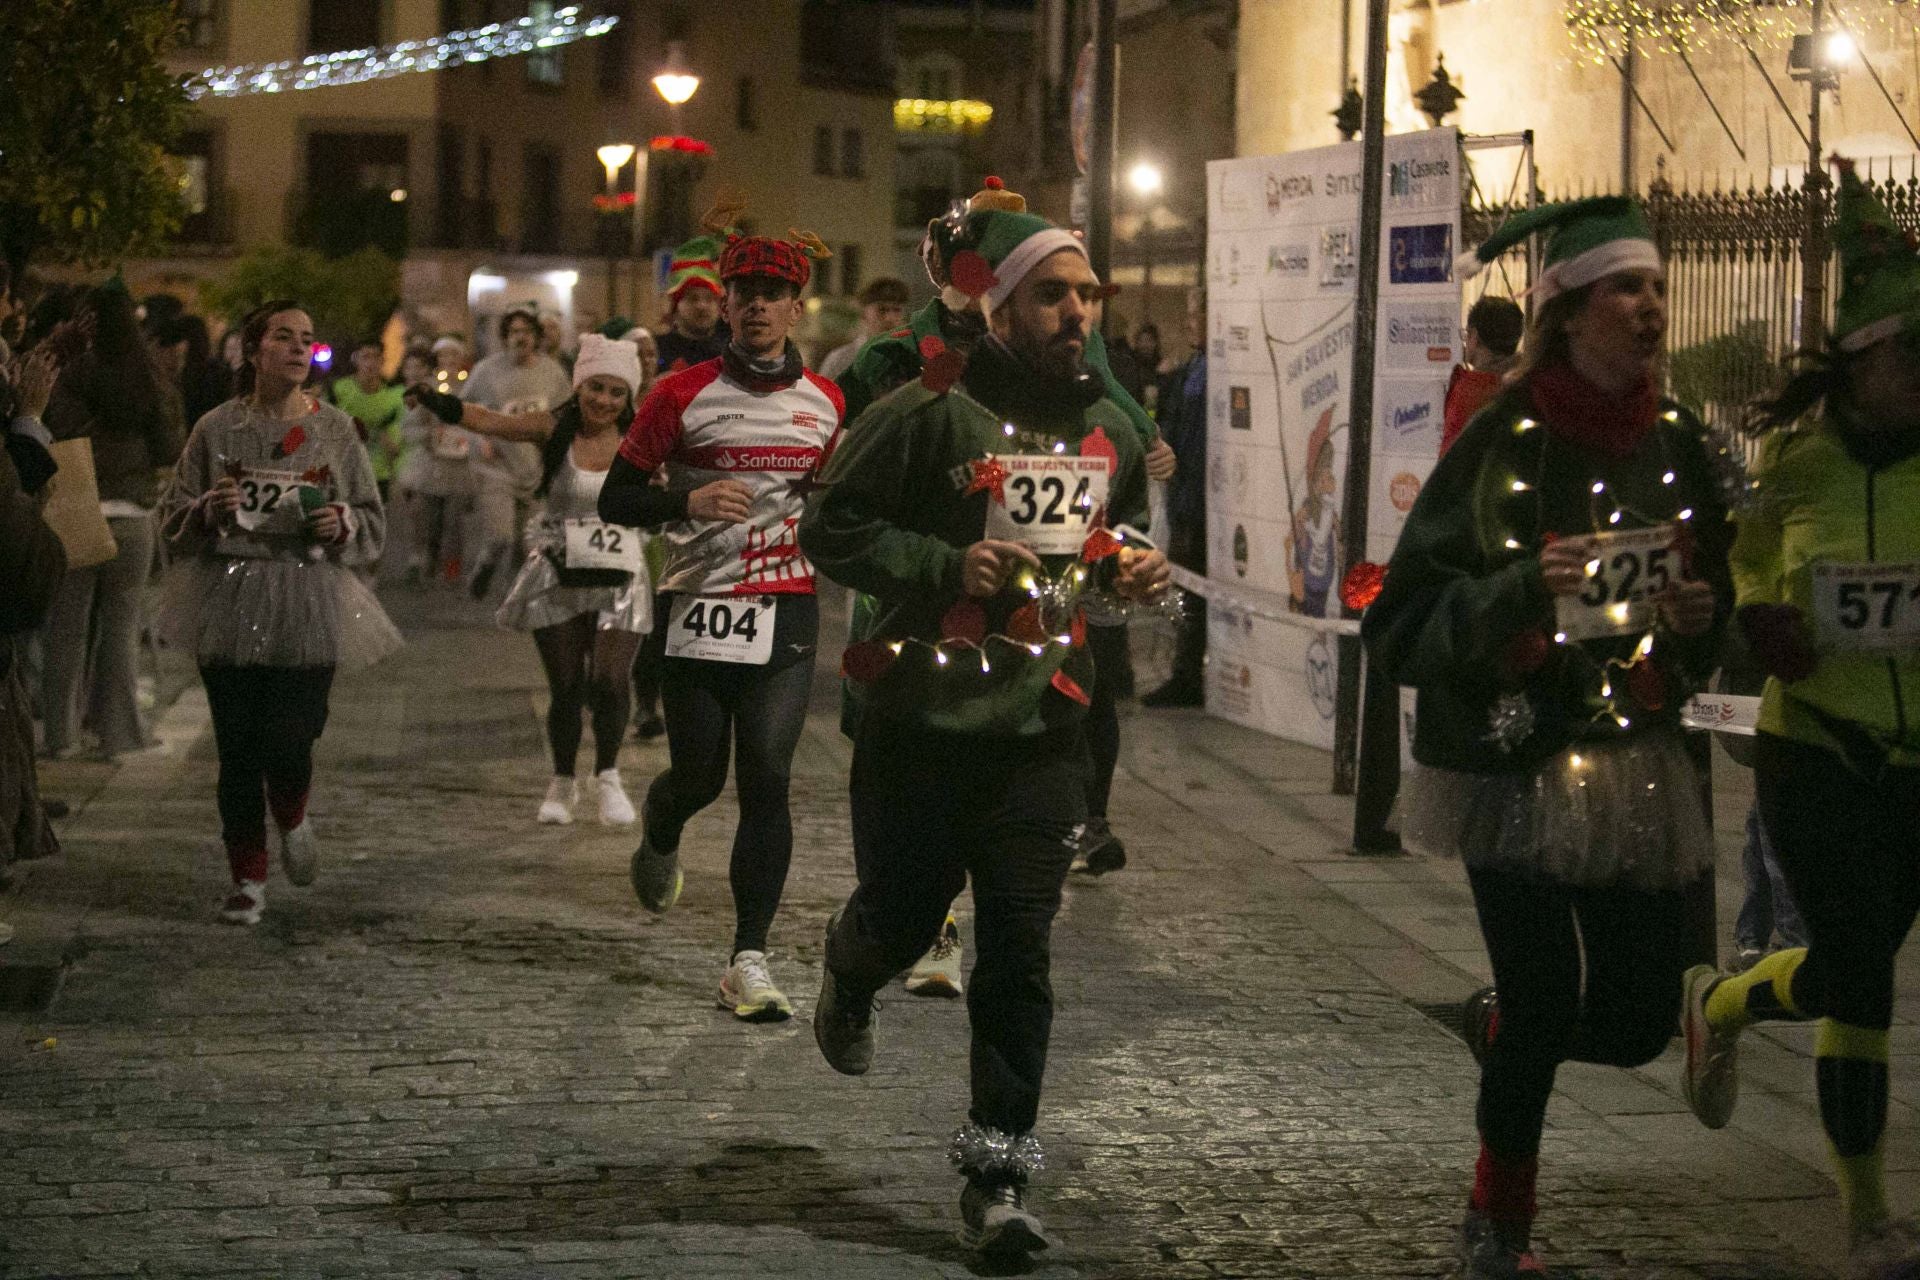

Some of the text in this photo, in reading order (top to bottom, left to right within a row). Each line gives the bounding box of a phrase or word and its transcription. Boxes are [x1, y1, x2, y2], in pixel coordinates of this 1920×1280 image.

[717, 413, 745, 421] FASTER
[739, 453, 816, 468] Santander
[239, 480, 300, 514] 32
[1010, 476, 1092, 525] 324
[589, 528, 623, 553] 42
[1579, 549, 1670, 608] 325
[682, 601, 758, 643] 404
